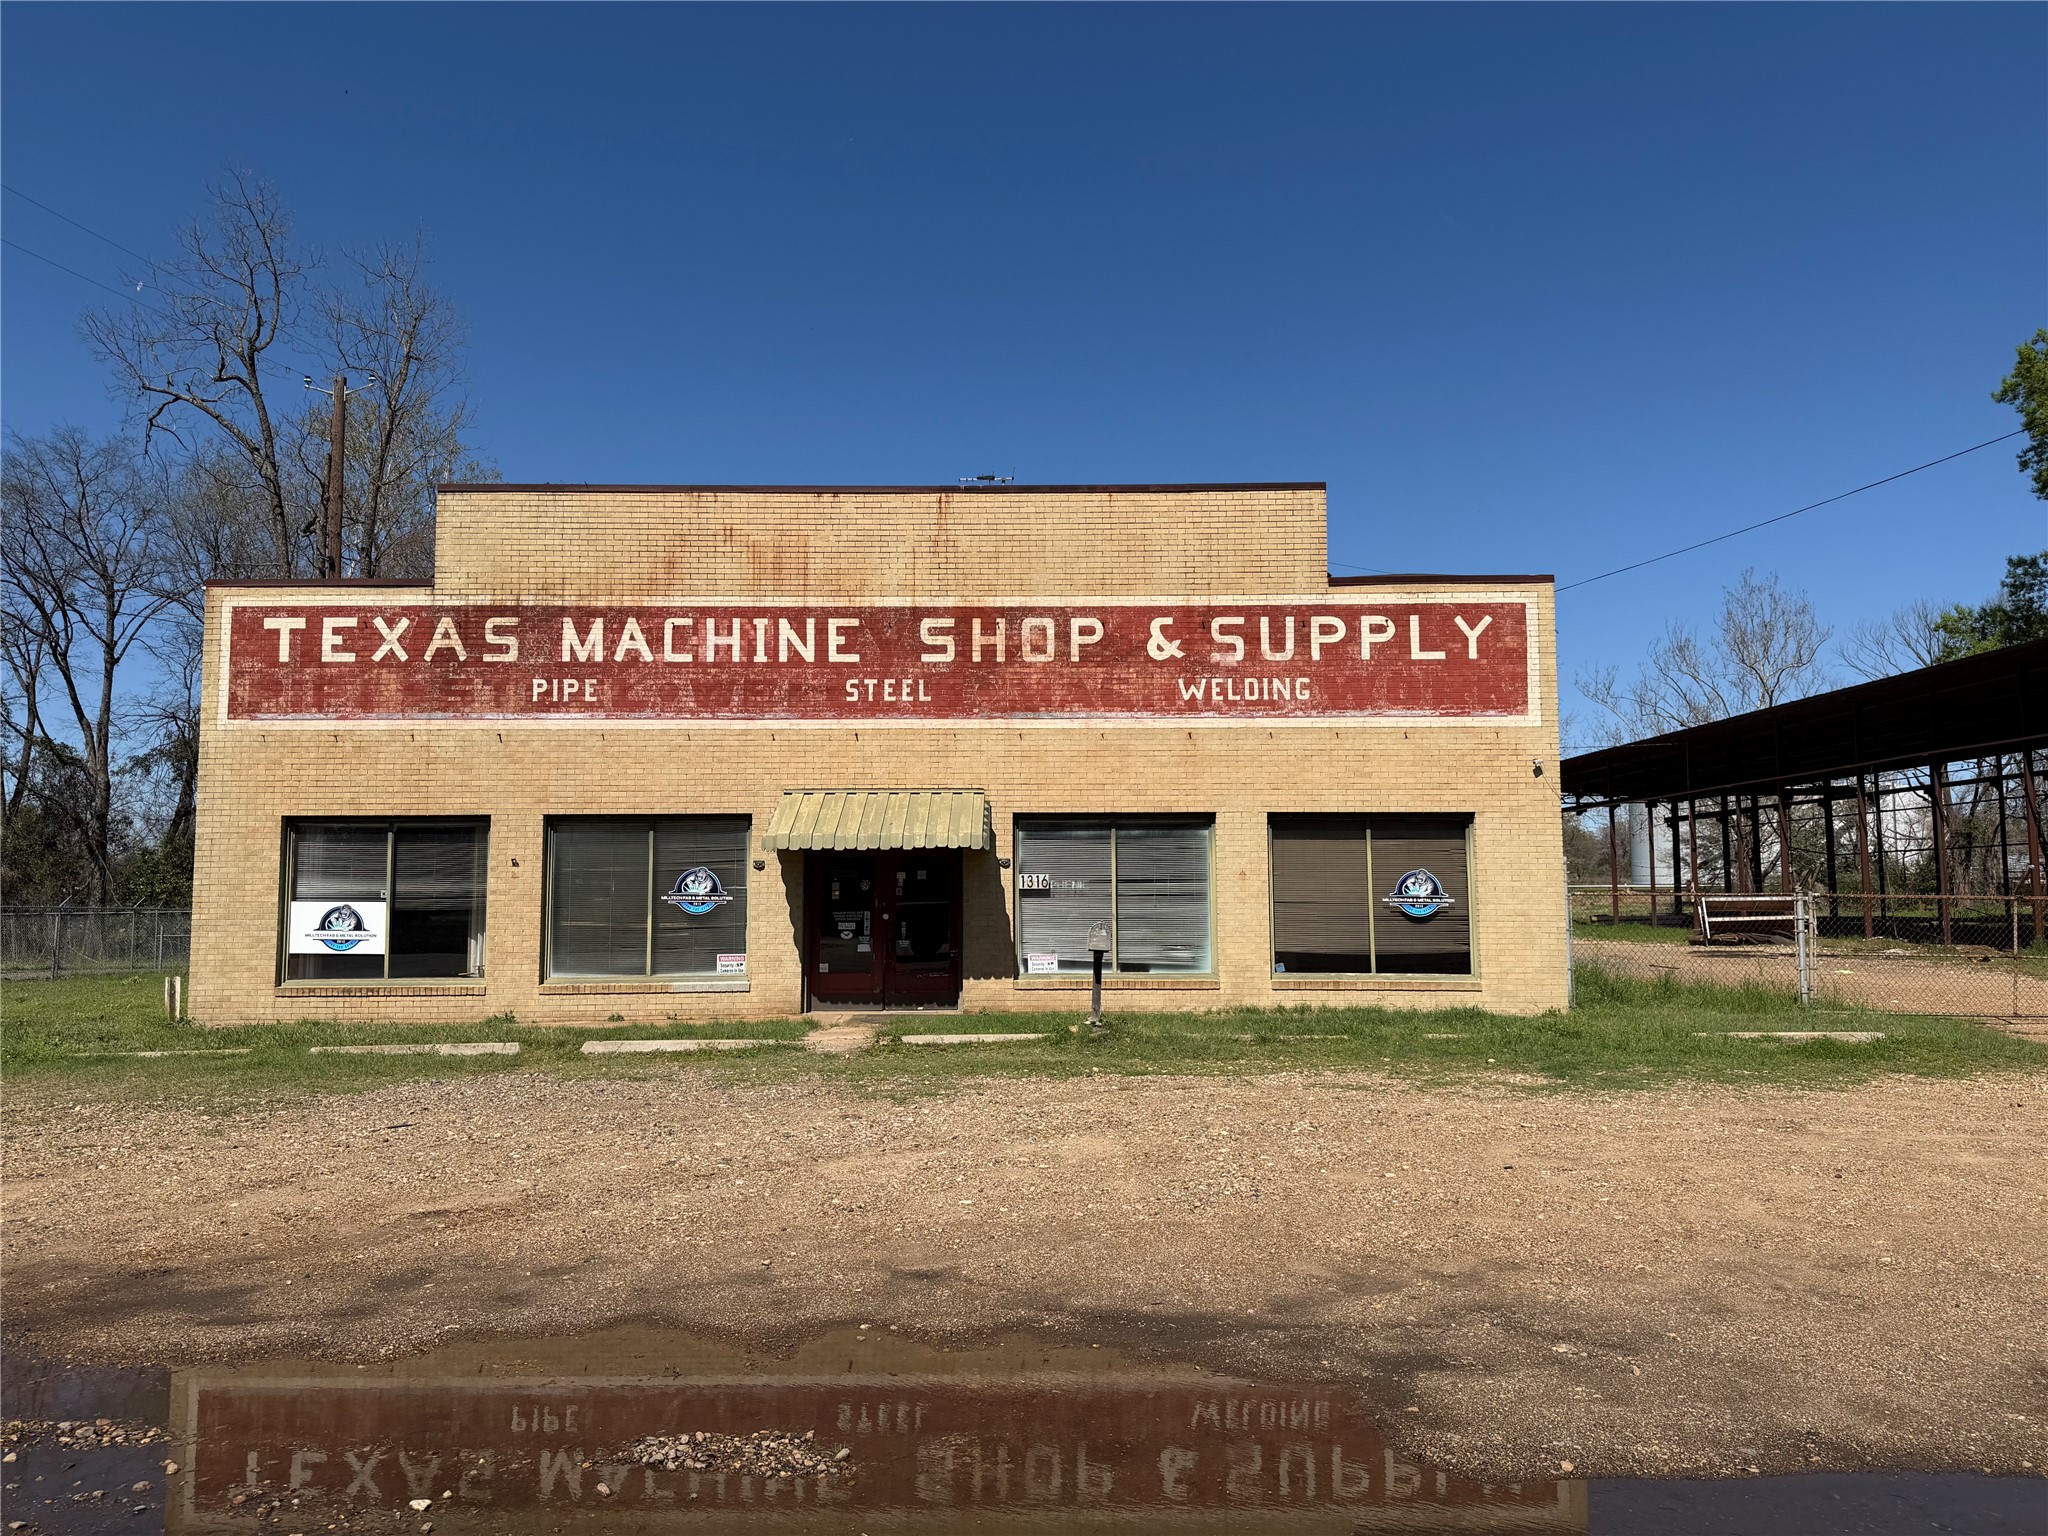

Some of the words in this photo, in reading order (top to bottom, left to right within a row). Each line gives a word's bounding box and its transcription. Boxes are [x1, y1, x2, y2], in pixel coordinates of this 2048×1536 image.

[263, 616, 520, 663] TEXAS
[561, 616, 860, 663] MACHINE
[920, 616, 1105, 662] SHOP
[1146, 616, 1186, 661] &
[1210, 614, 1493, 662] SUPPLY
[532, 678, 598, 702] PIPE
[845, 678, 932, 702] STEEL
[1177, 676, 1311, 701] WELDING
[1021, 875, 1049, 889] 1316
